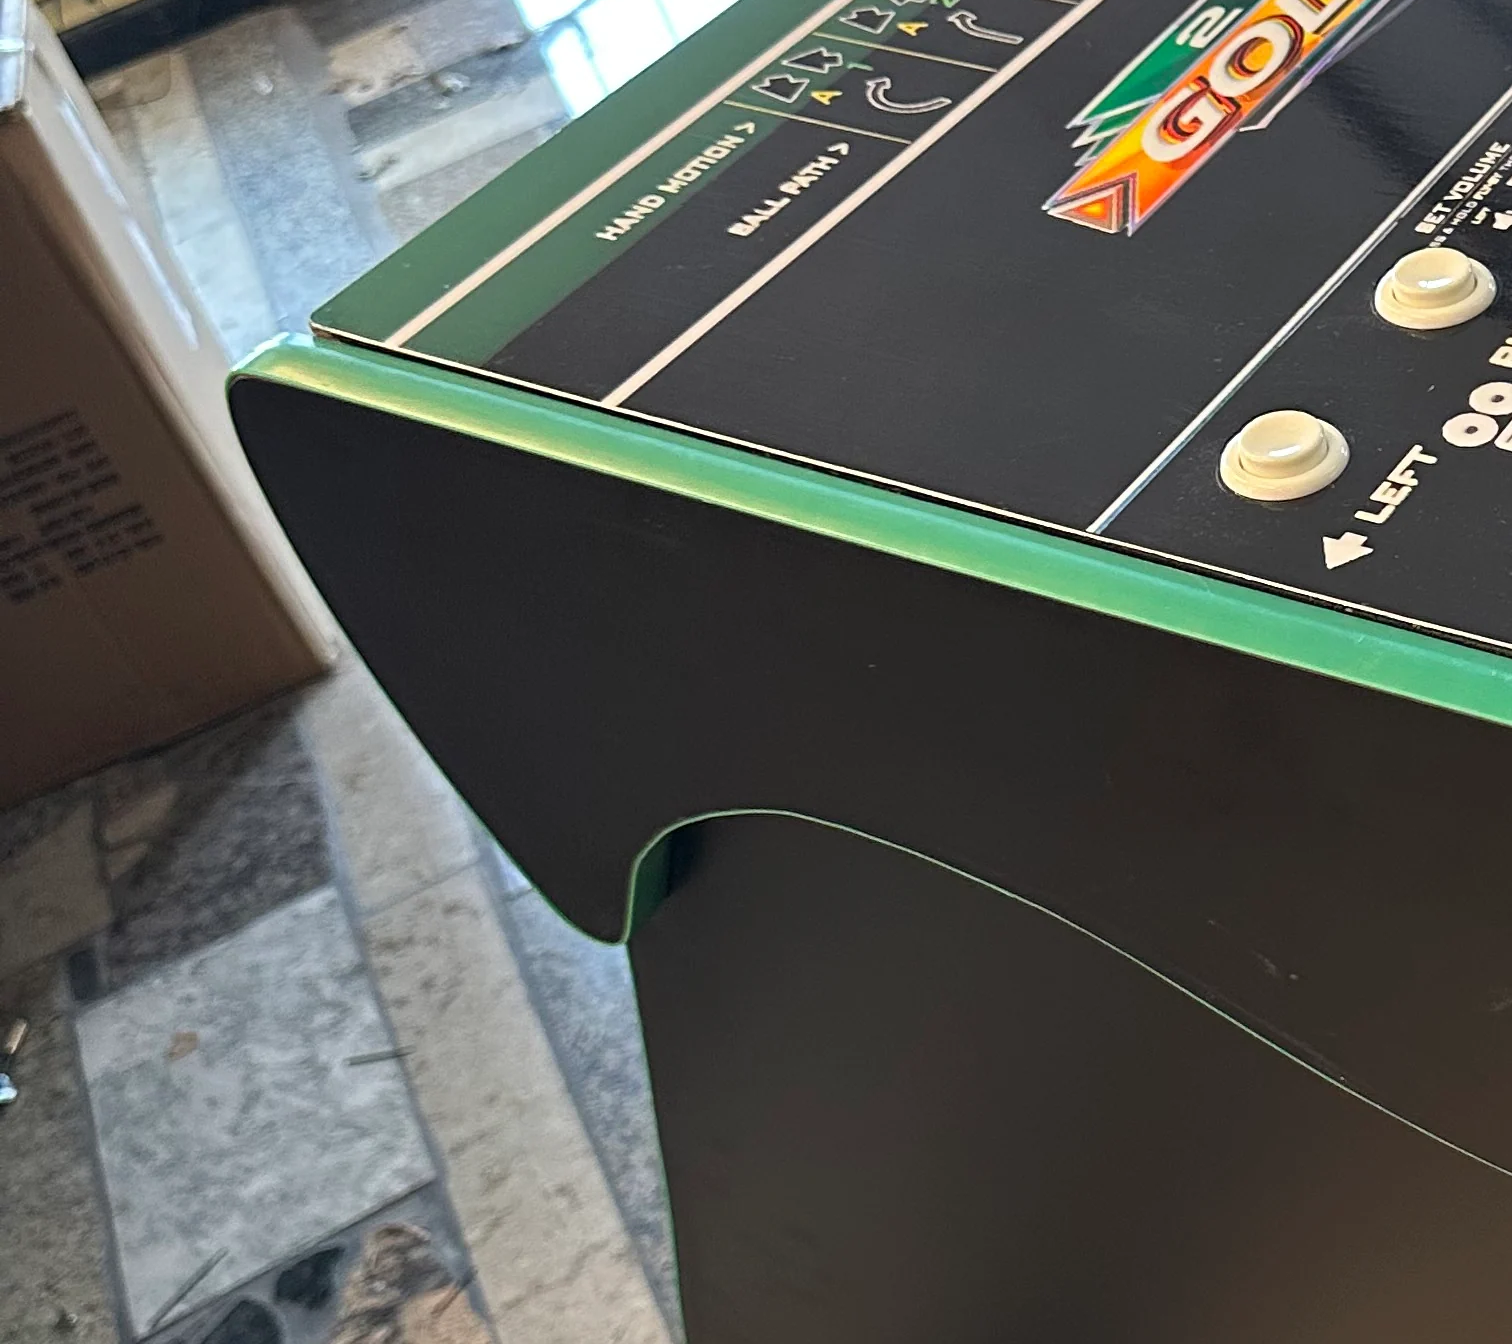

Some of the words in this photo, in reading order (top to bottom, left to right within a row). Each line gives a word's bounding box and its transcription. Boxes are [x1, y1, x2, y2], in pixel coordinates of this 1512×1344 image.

[897, 20, 929, 37] A
[810, 89, 843, 105] A
[595, 194, 666, 242] HAND
[657, 132, 746, 194] MOTION
[727, 196, 791, 238] BALL
[779, 153, 840, 196] PATH
[1414, 202, 1452, 234] SET
[1443, 141, 1511, 201] VOLUME
[1354, 443, 1438, 526] LEFT
